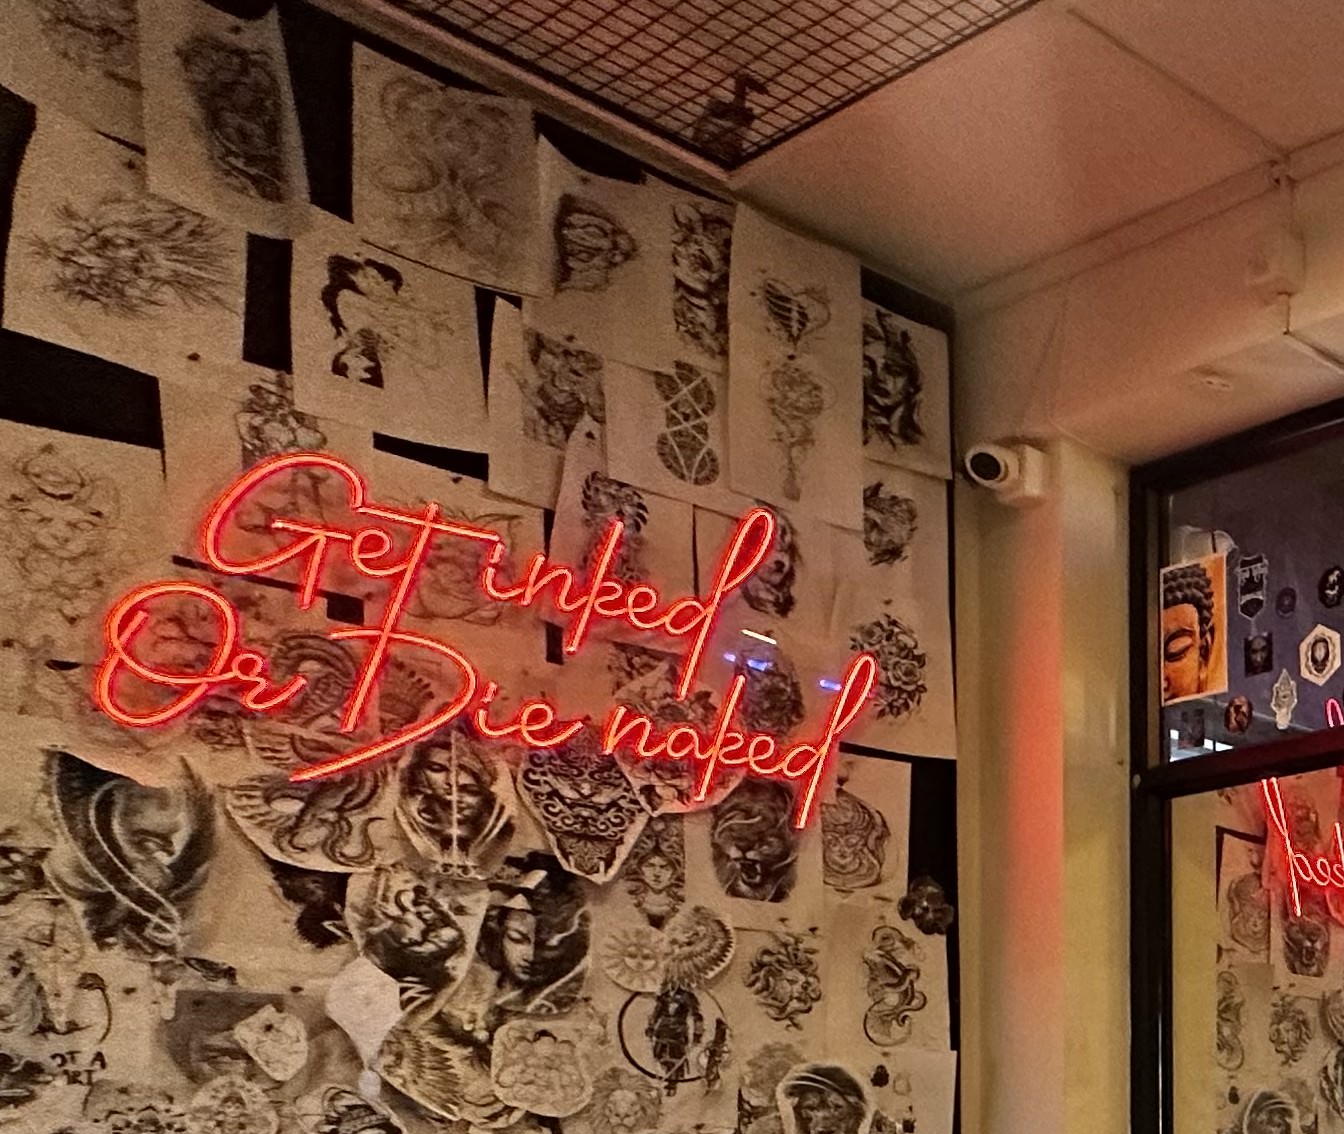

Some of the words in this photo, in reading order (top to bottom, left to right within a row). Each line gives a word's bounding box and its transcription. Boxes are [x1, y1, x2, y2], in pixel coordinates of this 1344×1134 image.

[98, 581, 306, 727] Or
[290, 628, 584, 782] Die
[603, 654, 878, 829] naked
[204, 452, 500, 732] Get
[482, 509, 776, 701] inked
